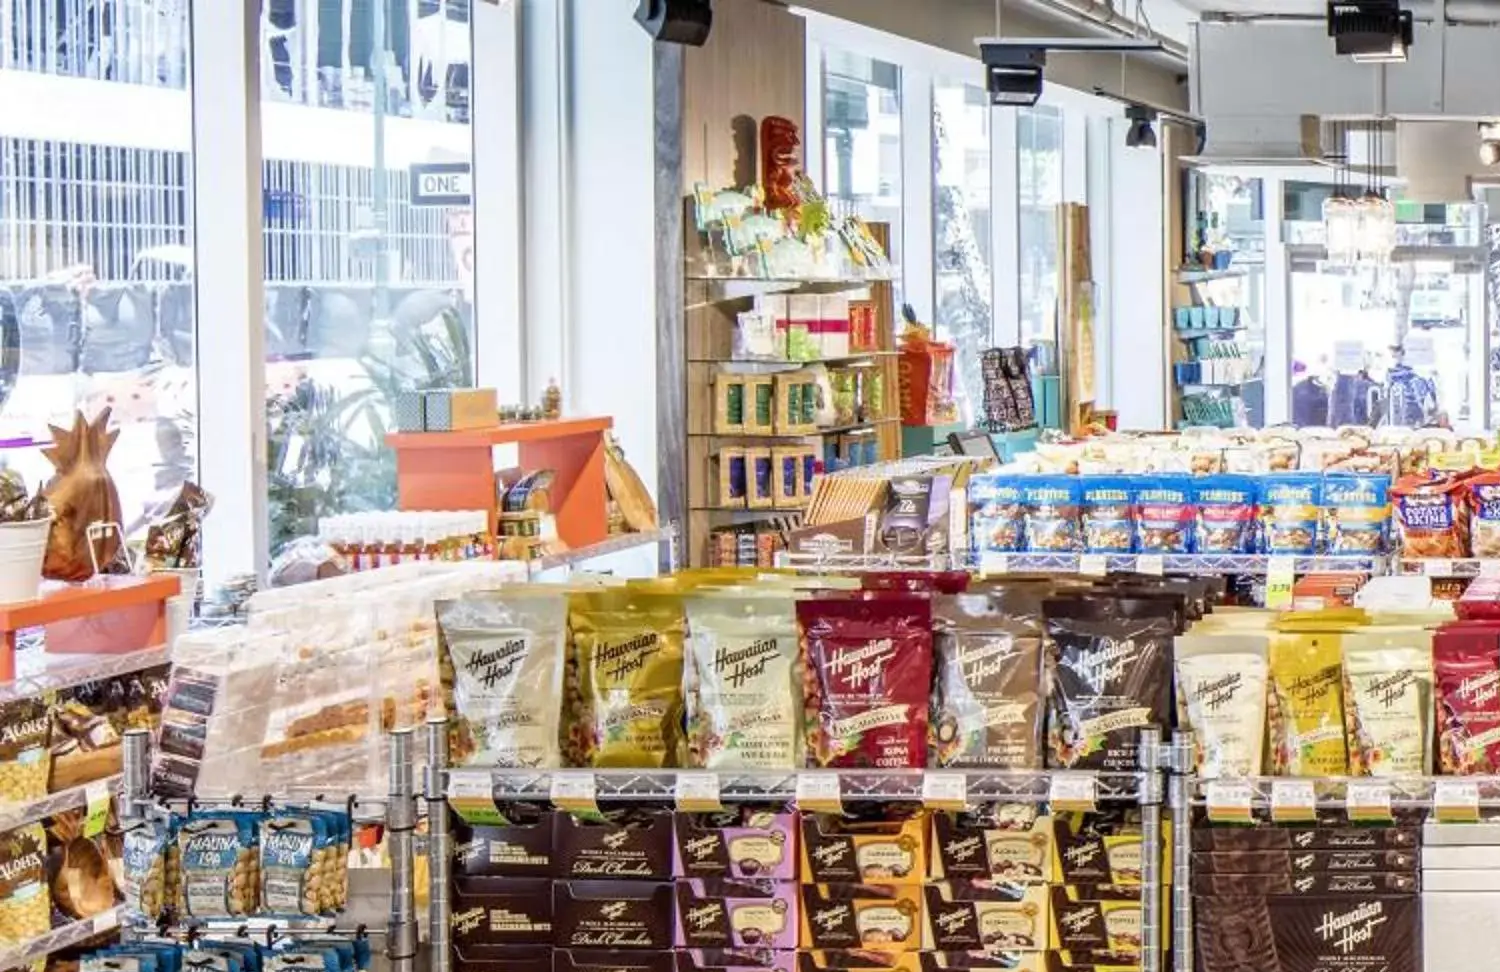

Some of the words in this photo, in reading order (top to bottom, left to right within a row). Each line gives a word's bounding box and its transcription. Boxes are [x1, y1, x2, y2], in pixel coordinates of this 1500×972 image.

[425, 176, 461, 193] ONE
[465, 639, 526, 674] Hawaiian
[590, 633, 657, 669] Hawaiian
[606, 648, 660, 681] Host
[708, 639, 777, 673] Hawaiian
[823, 639, 893, 675] Hawaiian
[478, 654, 529, 689] Host
[724, 653, 781, 687] Host
[842, 652, 896, 689] Host
[190, 835, 239, 852] MAUNA
[1315, 901, 1382, 940] Hawaiian
[1334, 916, 1387, 953] Host
